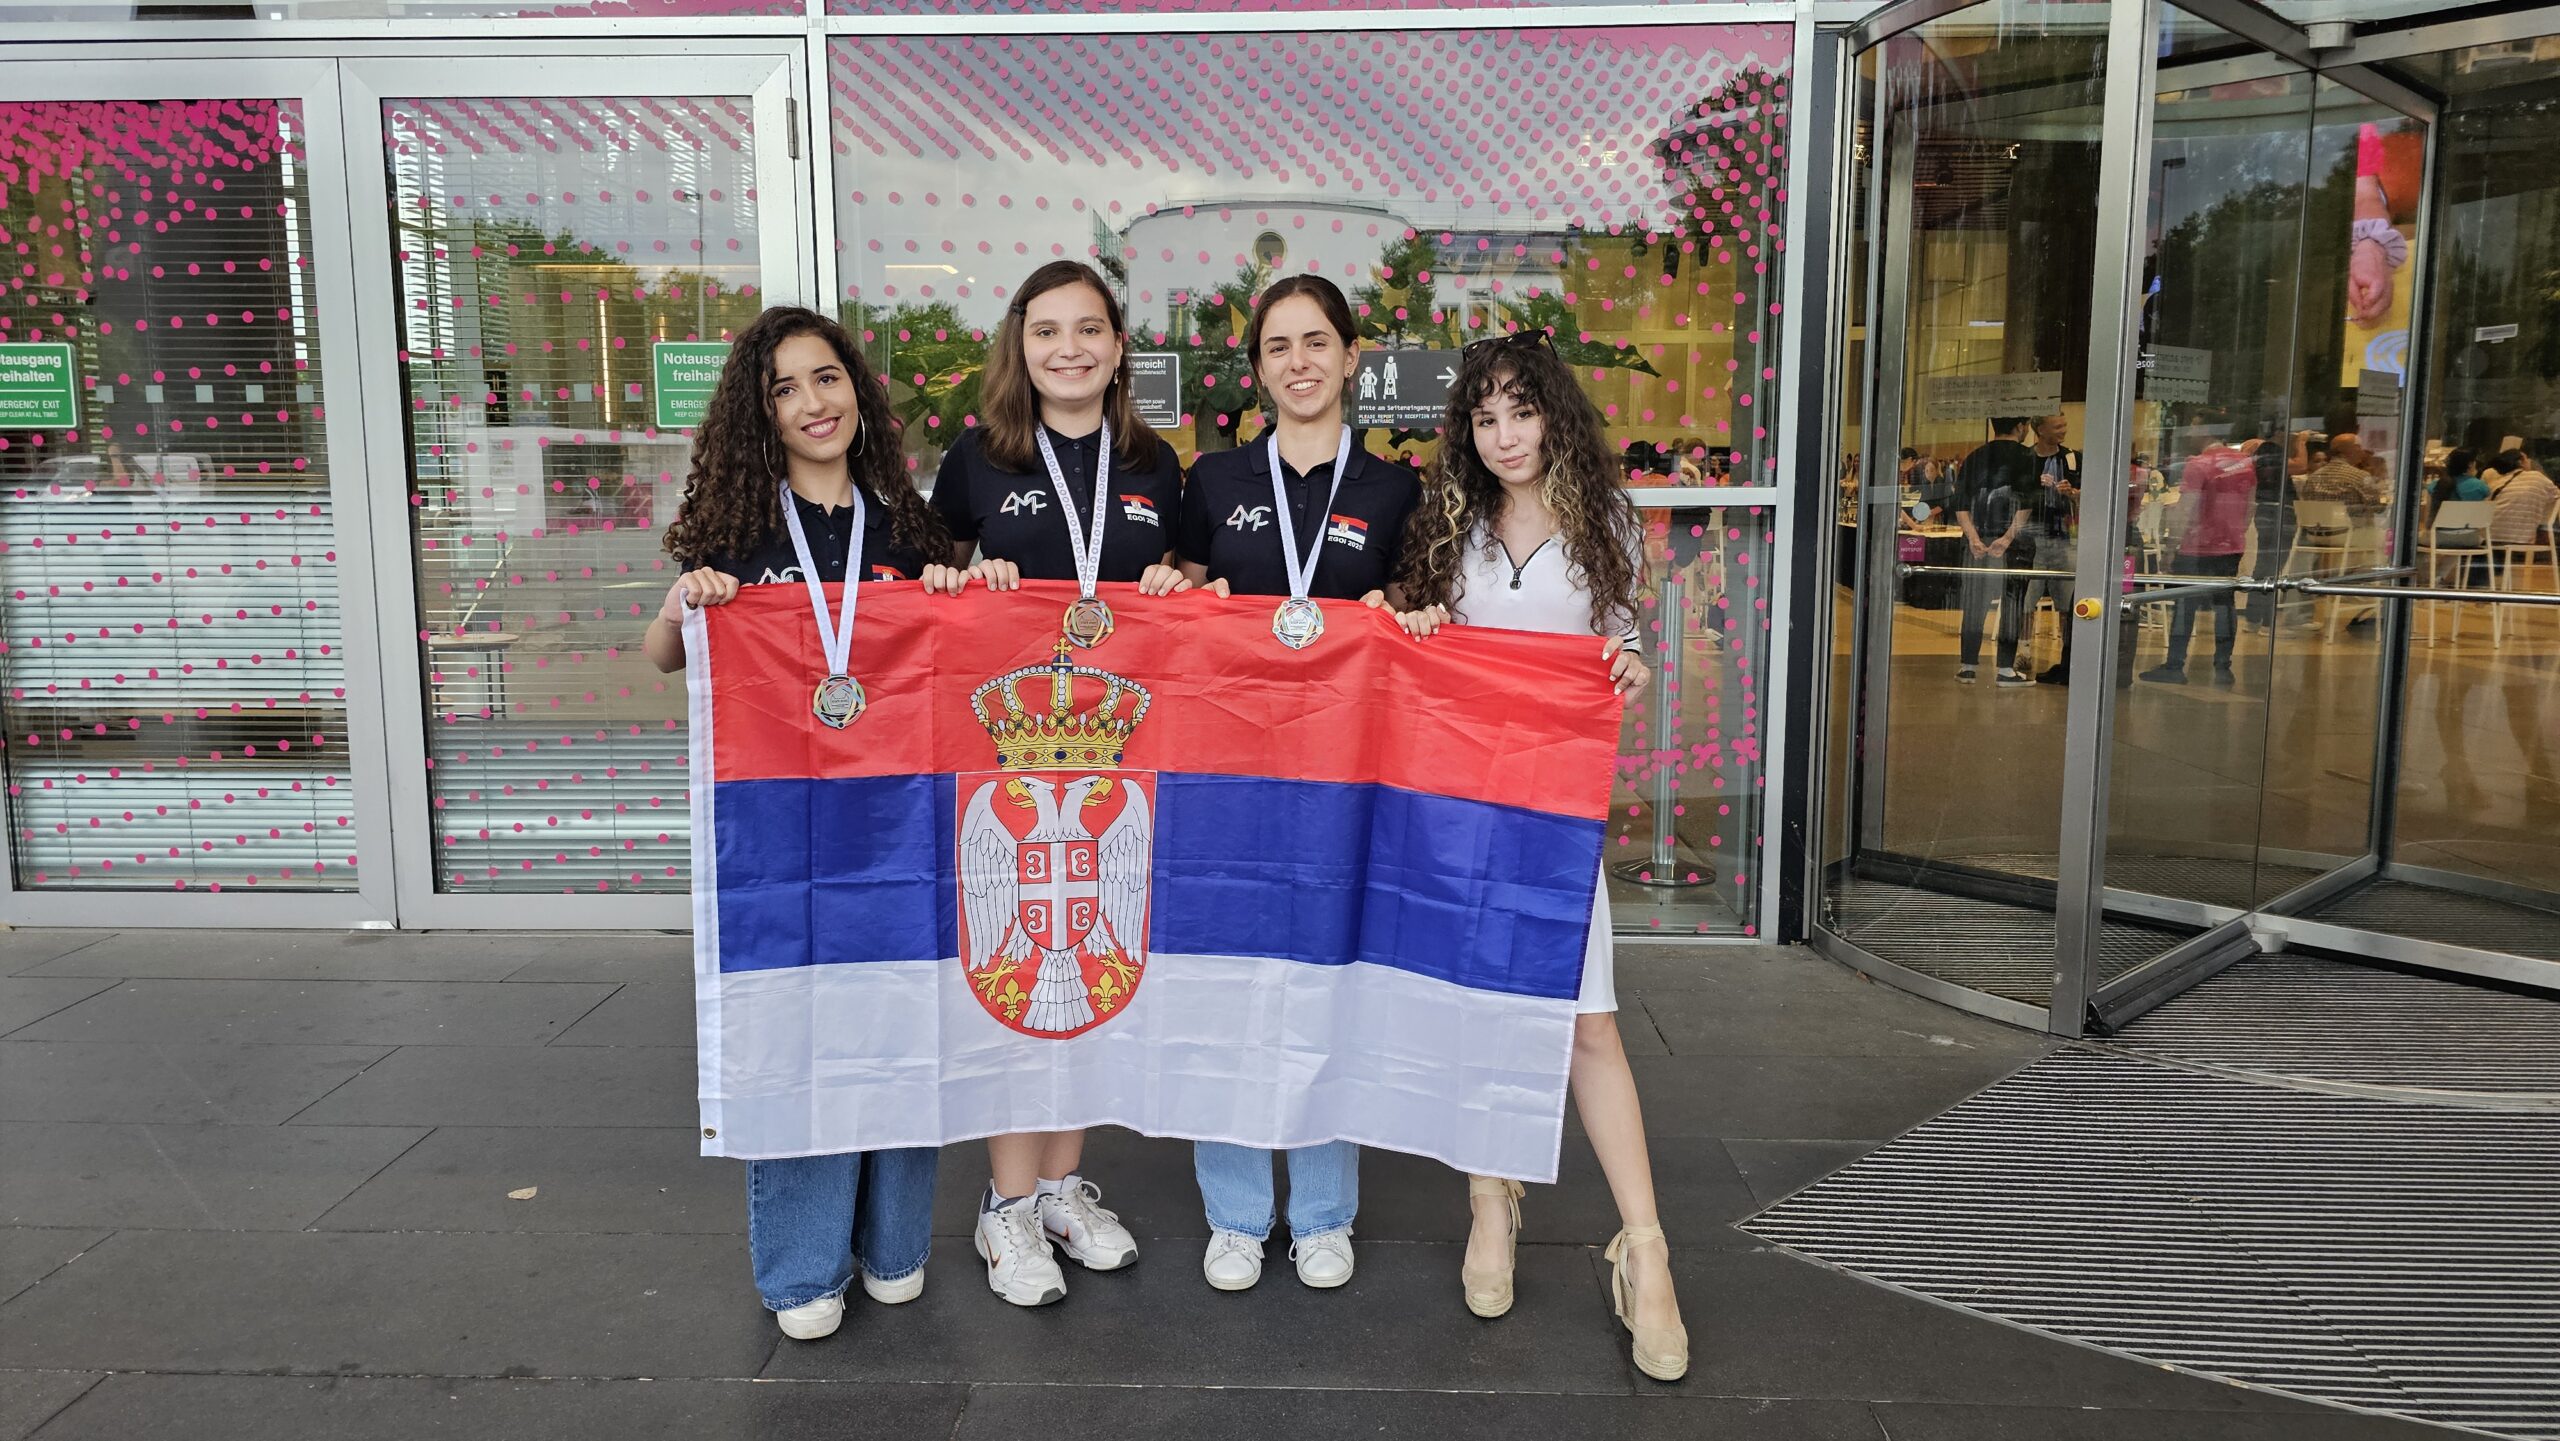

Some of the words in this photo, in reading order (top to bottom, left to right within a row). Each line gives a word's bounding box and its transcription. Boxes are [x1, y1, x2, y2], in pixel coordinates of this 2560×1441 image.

[0, 354, 61, 368] tausgang
[664, 353, 728, 367] Notausga
[1128, 359, 1166, 369] bereich!
[673, 370, 721, 381] freihalt
[42, 400, 60, 409] EXIT
[1387, 404, 1431, 412] Seiteneingang
[1126, 513, 1146, 523] EGOI
[1327, 535, 1347, 545] EGOI
[1347, 540, 1363, 551] 2025
